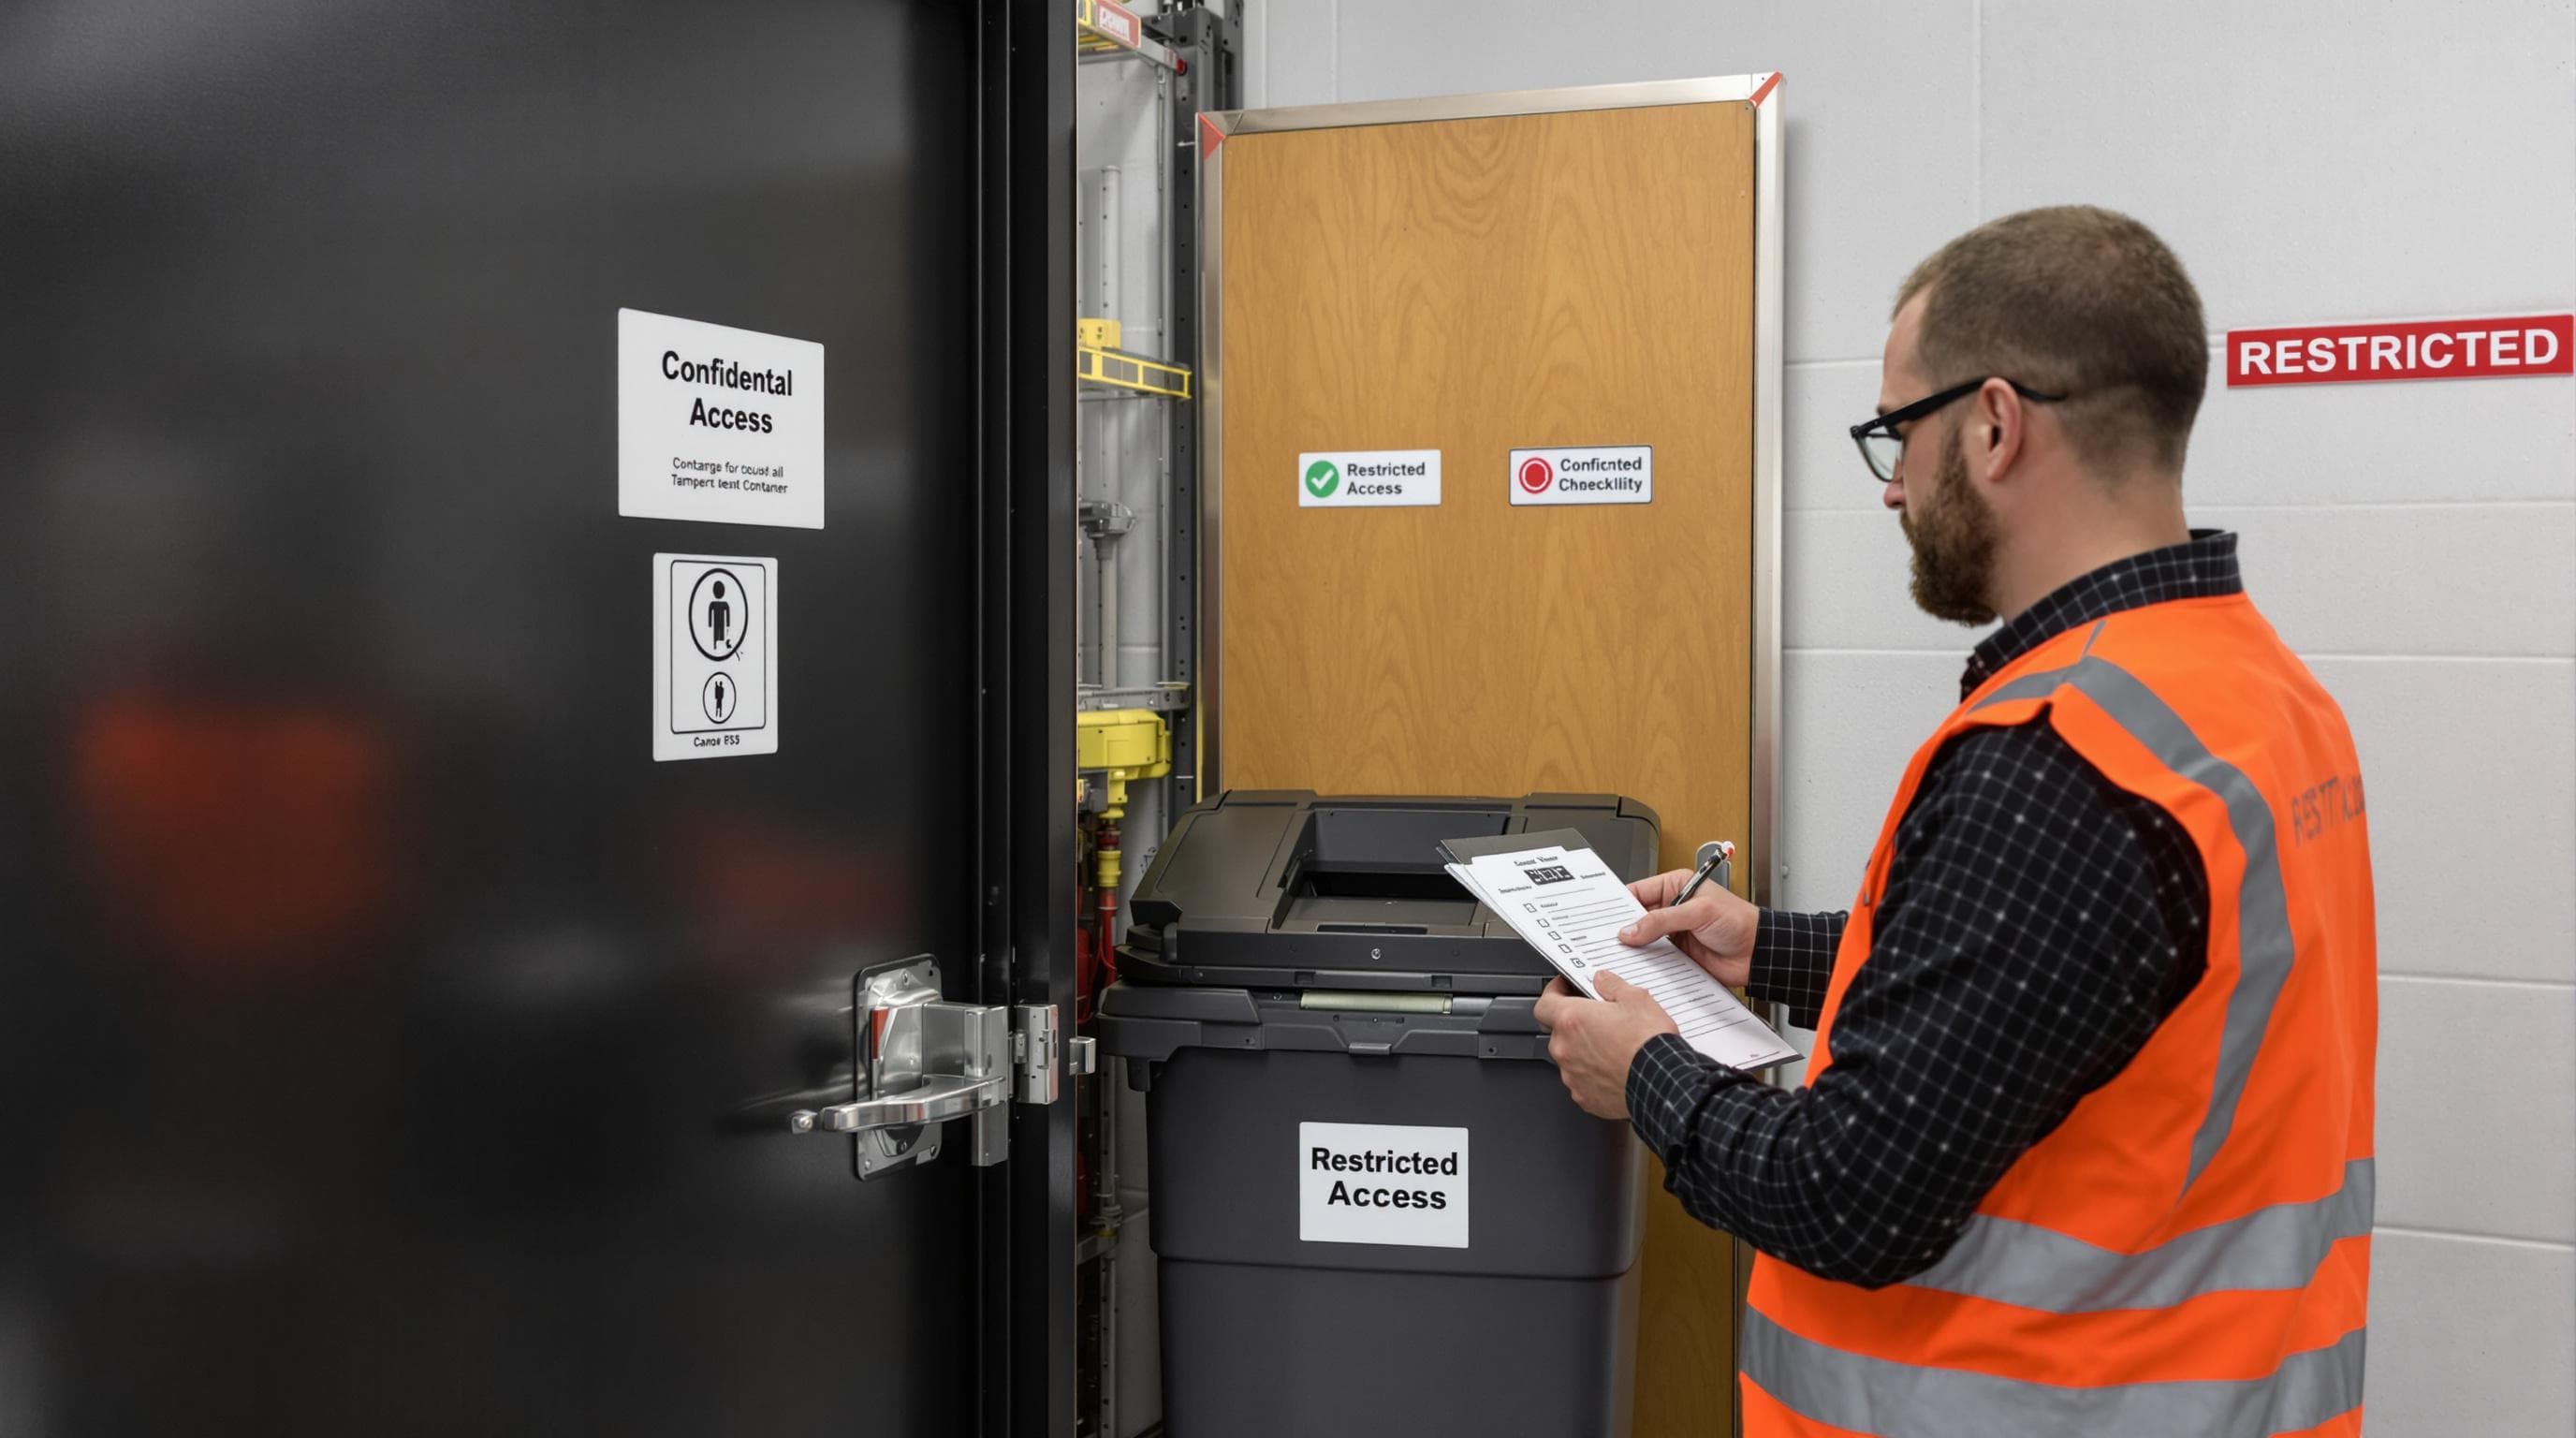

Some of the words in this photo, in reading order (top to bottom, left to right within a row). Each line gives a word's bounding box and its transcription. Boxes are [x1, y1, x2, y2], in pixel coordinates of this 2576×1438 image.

[2240, 329, 2558, 375] RESTRICTED
[663, 351, 792, 396] Confidental
[690, 398, 772, 433] Access
[724, 461, 739, 473] for
[1347, 462, 1425, 477] Restricted
[1346, 481, 1402, 494] Access
[1312, 1147, 1457, 1175] Restricted
[1328, 1181, 1446, 1210] Access
